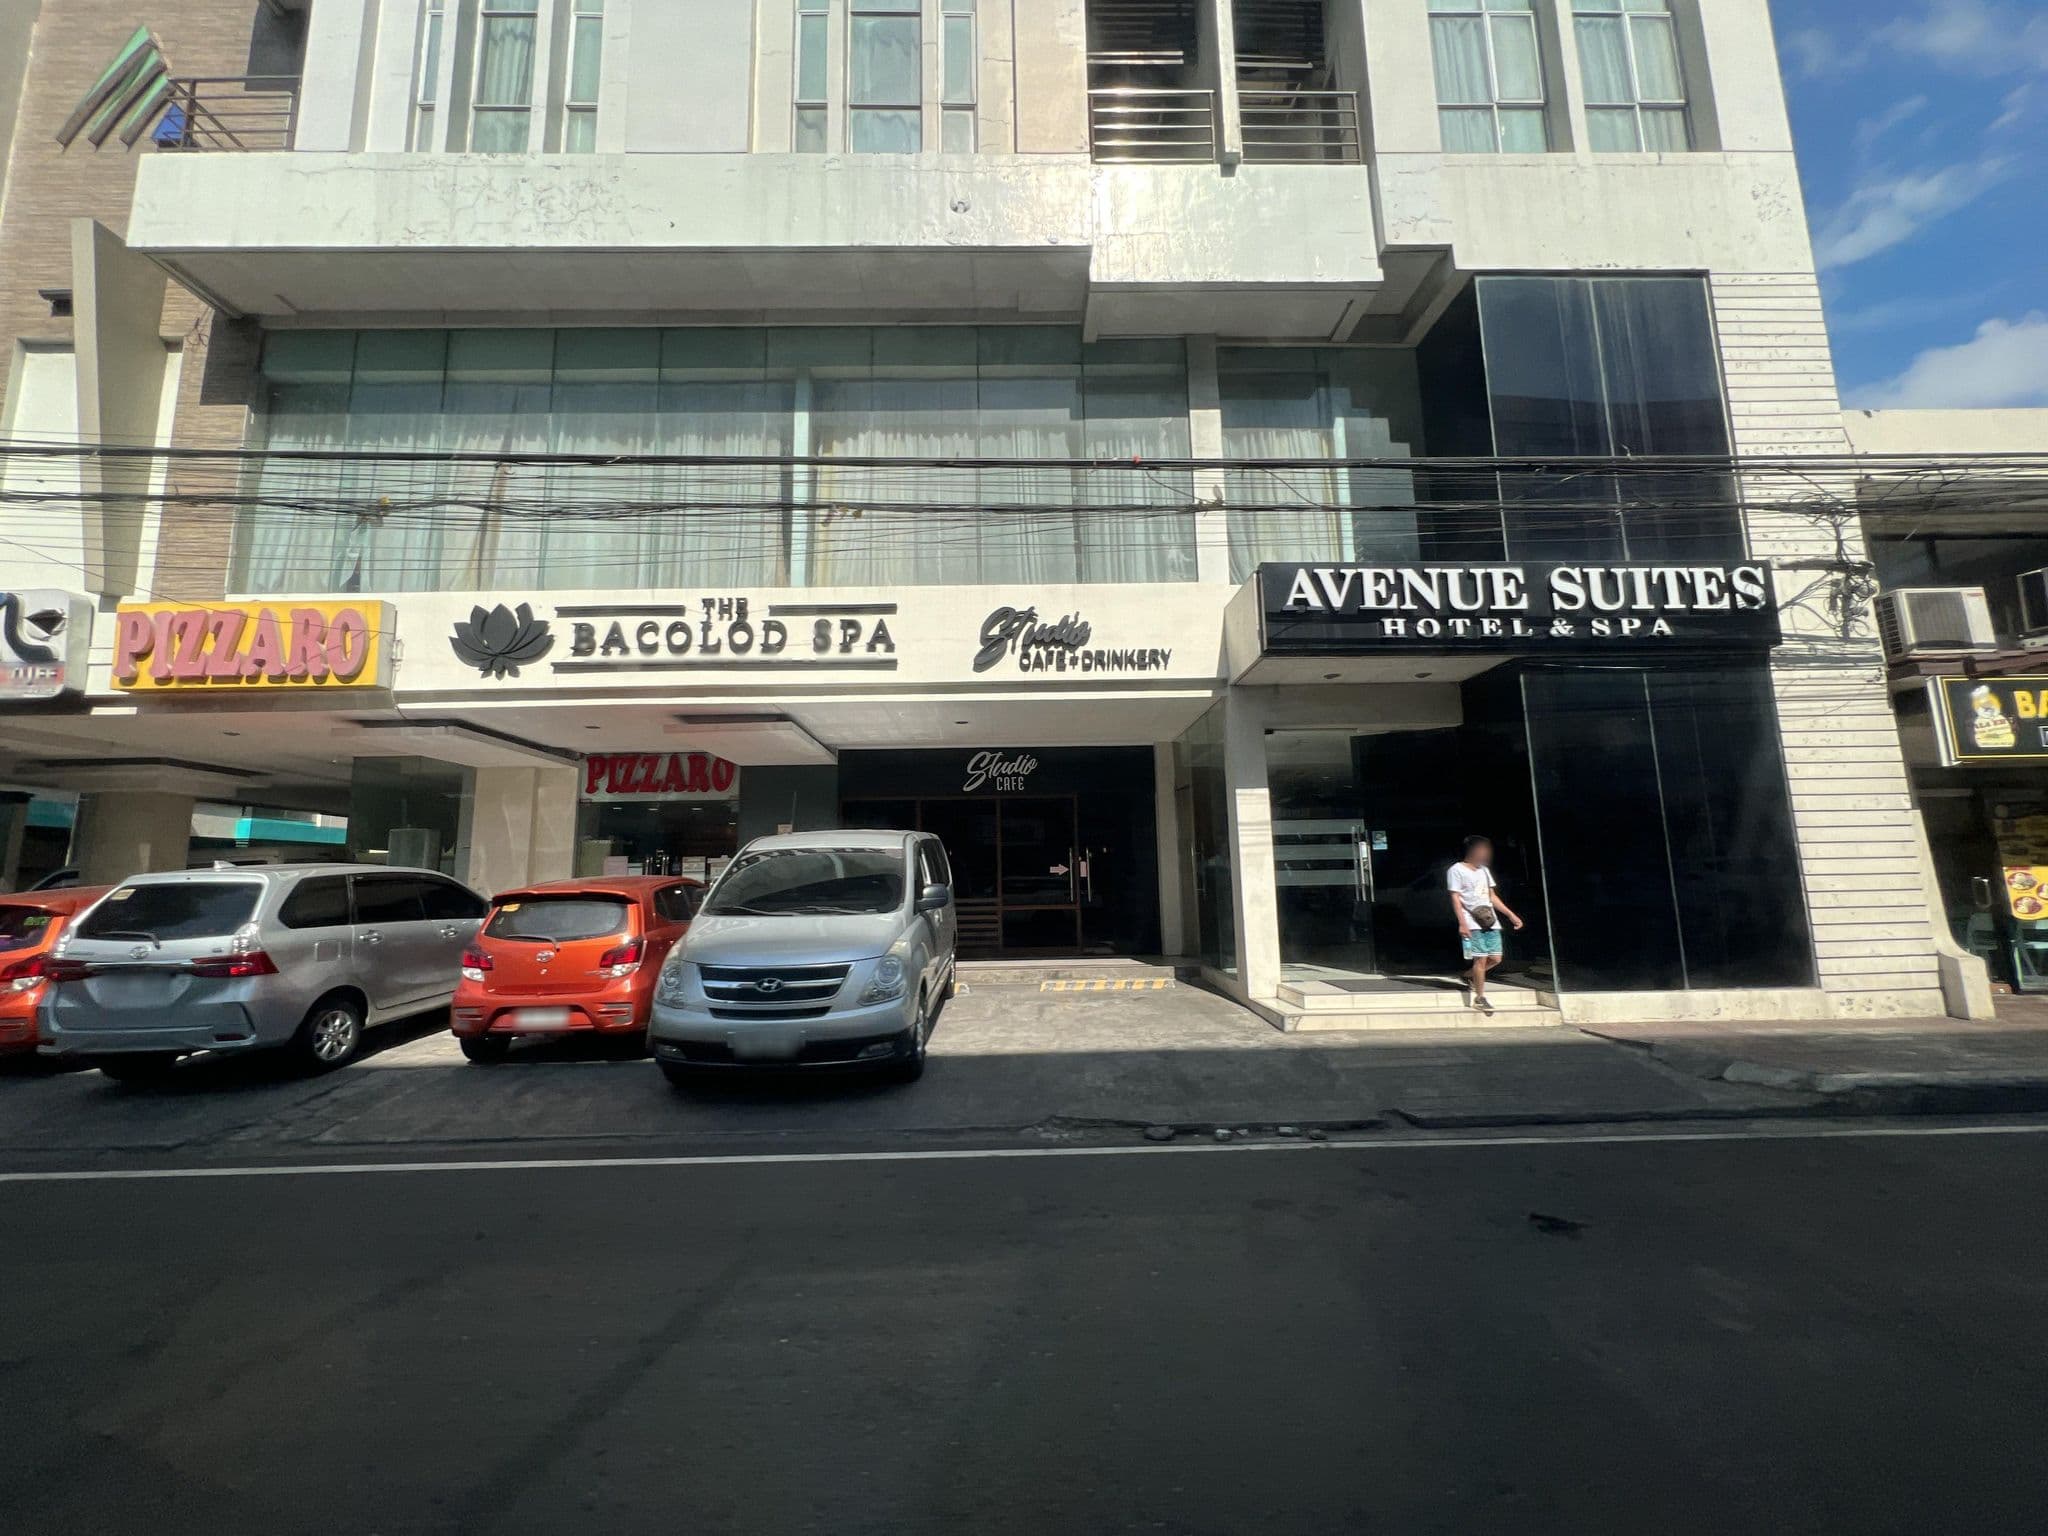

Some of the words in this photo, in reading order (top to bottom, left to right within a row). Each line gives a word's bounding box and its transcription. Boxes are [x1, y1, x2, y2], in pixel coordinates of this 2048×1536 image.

[701, 597, 749, 621] THE
[1283, 567, 1528, 612] AVENUE
[1551, 566, 1767, 611] SUITES
[113, 607, 369, 685] PIZZARO
[571, 619, 788, 657] BACOLOD
[813, 617, 896, 654] SPA
[1382, 617, 1533, 638] HOTEL
[1550, 617, 1575, 637] &
[1591, 617, 1674, 637] SPA
[586, 754, 736, 794] PIZZARO
[963, 751, 1038, 792] Studio
[996, 776, 1025, 791] CAFE
